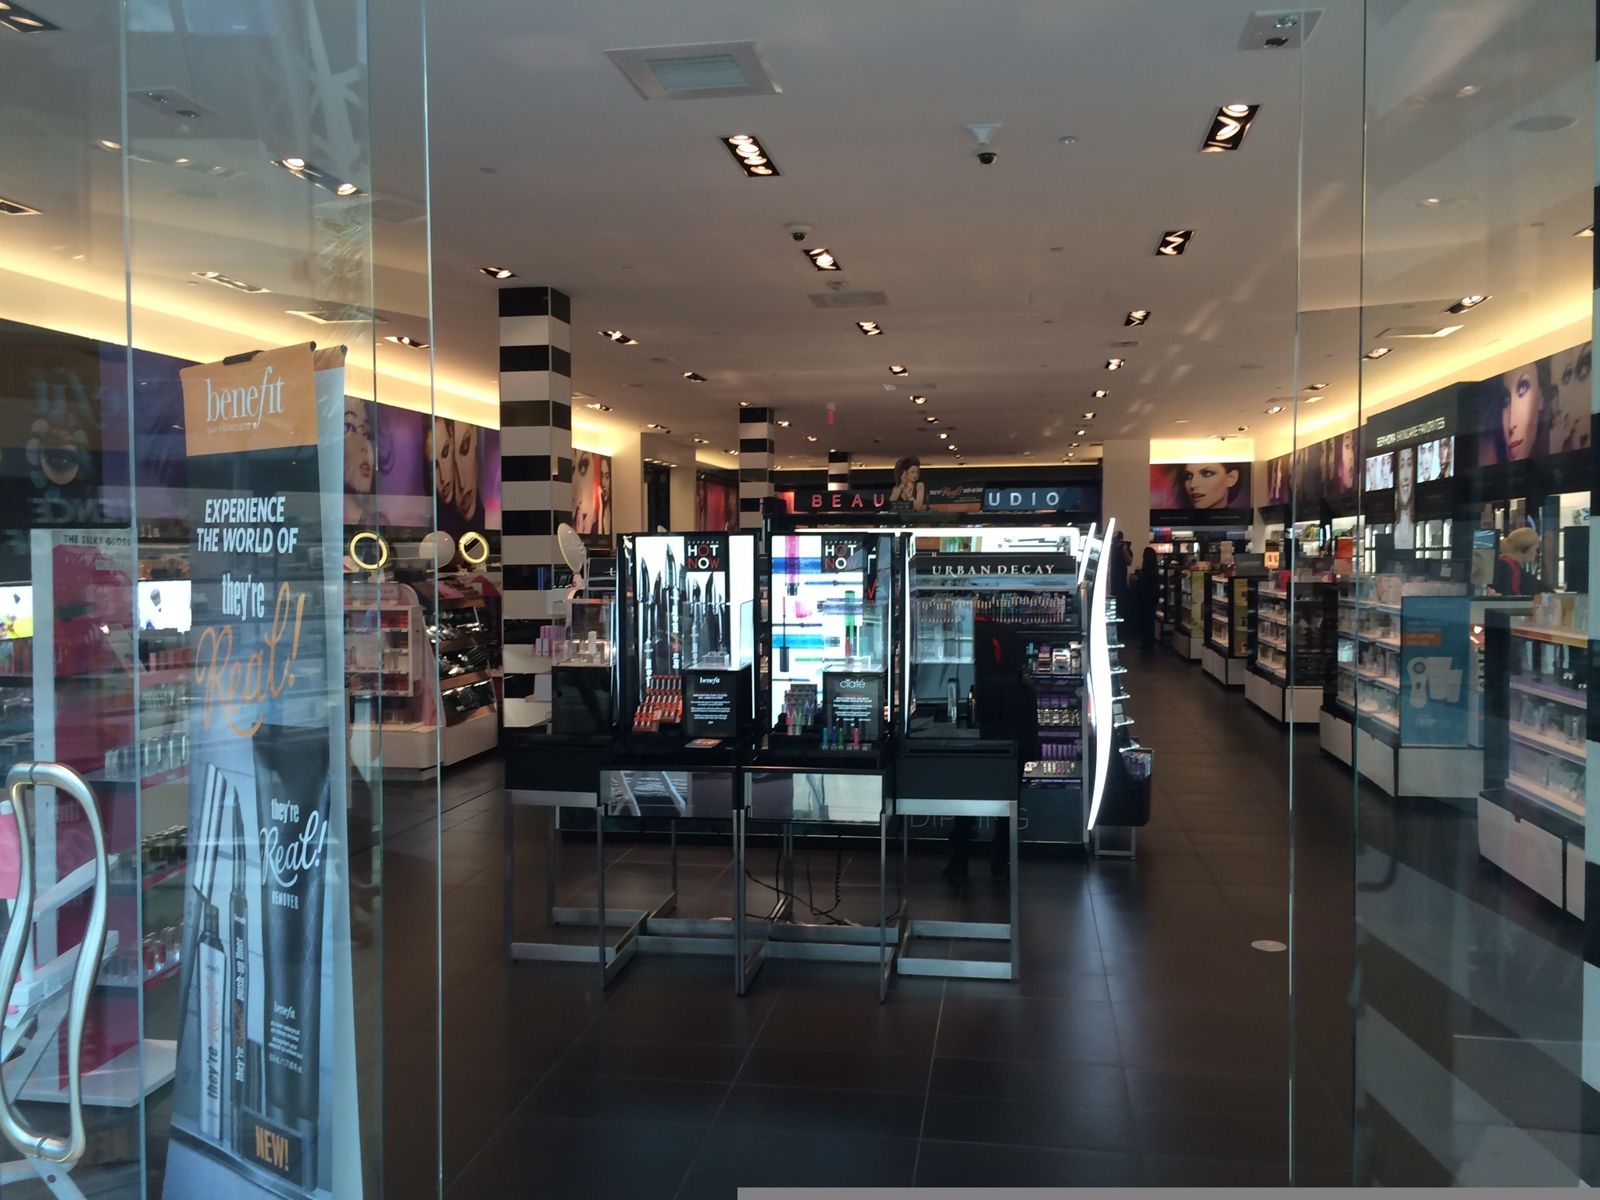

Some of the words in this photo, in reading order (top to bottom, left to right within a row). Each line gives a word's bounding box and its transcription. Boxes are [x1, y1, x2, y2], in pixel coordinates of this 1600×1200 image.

[204, 366, 285, 430] benefit
[205, 496, 286, 523] EXPERIENCE
[811, 493, 885, 508] BEAU
[988, 492, 1060, 507] UDIO
[63, 534, 78, 544] THE
[81, 535, 103, 546] SILKY
[139, 524, 161, 538] ila
[196, 527, 220, 552] THE
[223, 527, 273, 553] WORLD
[277, 527, 299, 554] OF
[687, 544, 719, 557] HOT
[824, 544, 857, 557] HOT
[687, 557, 720, 570] NOW
[824, 557, 857, 570] NOW
[932, 564, 994, 577] URBAN
[998, 564, 1055, 576] DECAY
[222, 573, 265, 621] they're
[195, 581, 305, 738] Real!
[271, 798, 300, 824] they're
[260, 810, 328, 888] Real!
[271, 890, 300, 910] REMOVER
[255, 1125, 289, 1172] NEW!
